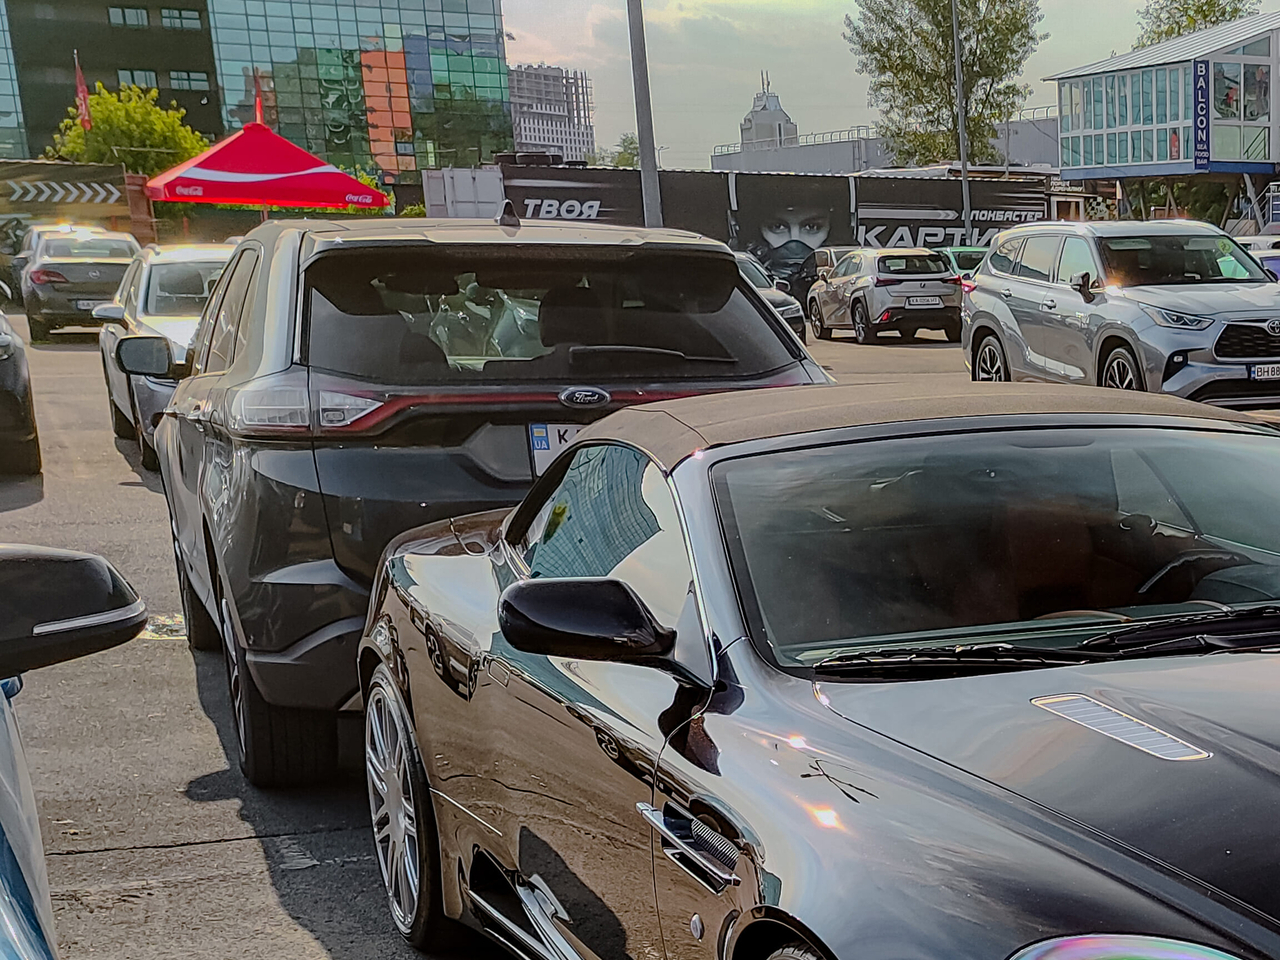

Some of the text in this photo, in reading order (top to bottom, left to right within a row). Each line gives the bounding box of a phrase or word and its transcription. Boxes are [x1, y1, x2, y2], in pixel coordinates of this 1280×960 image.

[1197, 63, 1207, 142] BALCON
[523, 198, 601, 219] ТВОЯ
[961, 209, 1044, 222] ЛОКБАСТЕР
[857, 225, 1008, 247] КАРТИ
[1256, 366, 1270, 377] BH
[572, 391, 599, 403] Ford
[533, 440, 548, 449] UA
